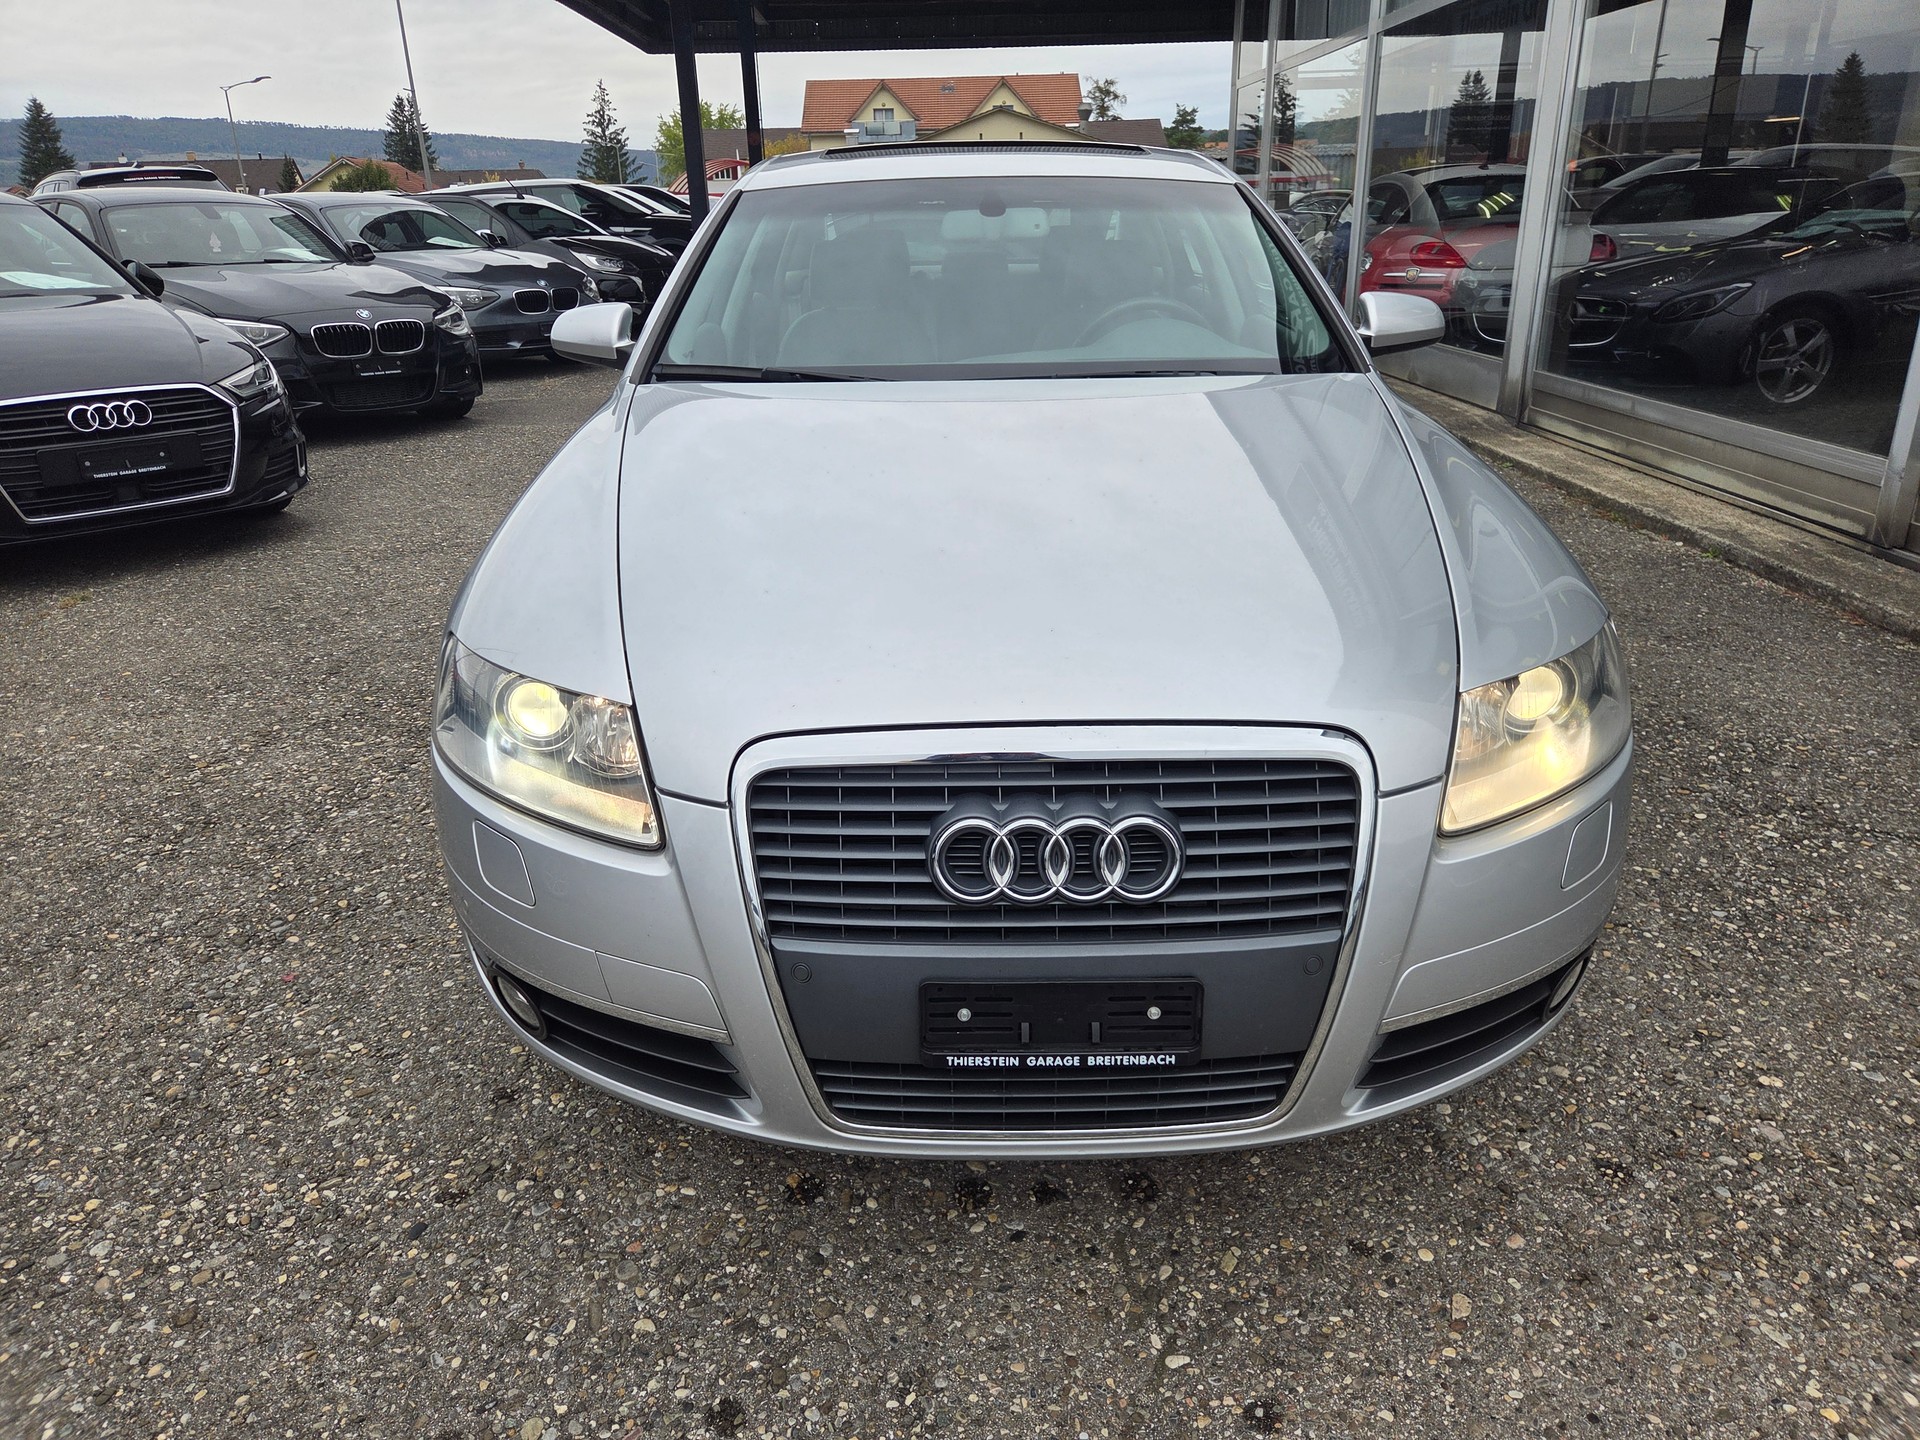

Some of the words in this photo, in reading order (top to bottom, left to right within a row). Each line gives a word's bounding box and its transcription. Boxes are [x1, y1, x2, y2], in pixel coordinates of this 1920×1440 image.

[93, 471, 118, 479] THIERSTEIN
[946, 1056, 1020, 1067] THIERSTEIN
[1026, 1056, 1081, 1067] GARAGE
[1087, 1054, 1176, 1066] BREITENBACH
